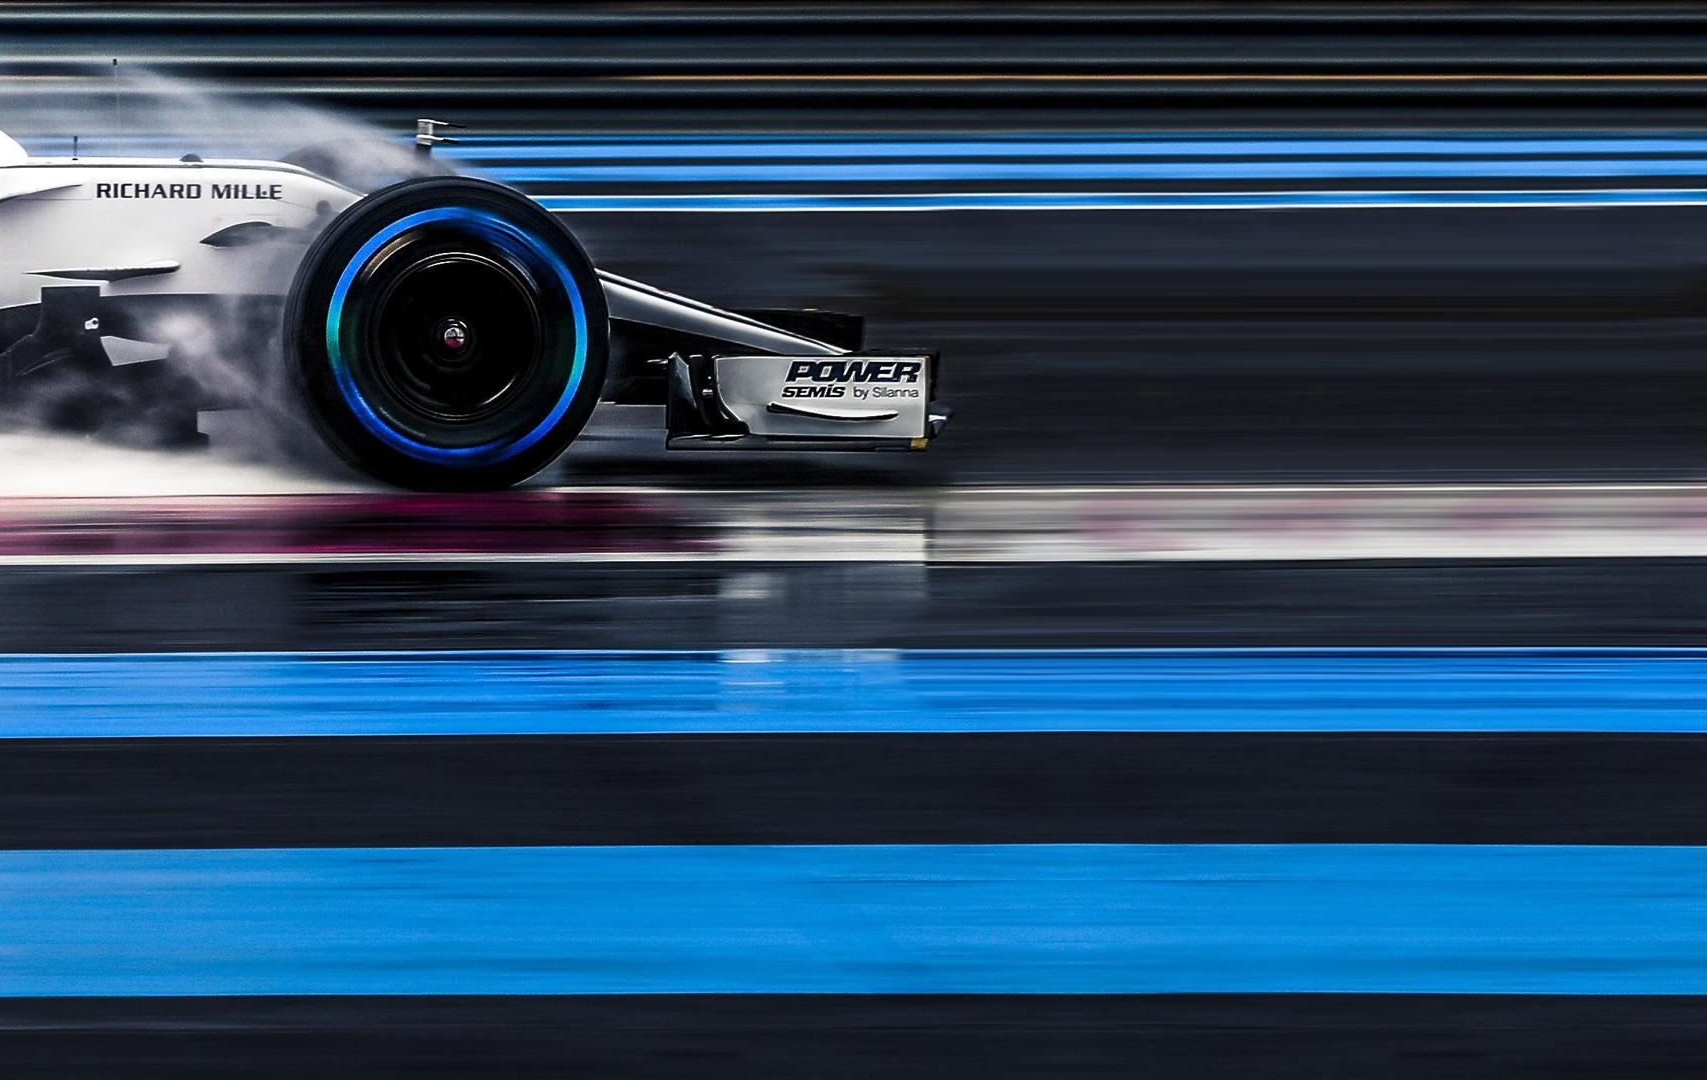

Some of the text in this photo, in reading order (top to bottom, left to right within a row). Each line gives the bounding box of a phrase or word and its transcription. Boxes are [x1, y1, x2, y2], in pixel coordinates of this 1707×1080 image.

[96, 183, 283, 200] RICHARD MILLE
[785, 361, 922, 383] POWER
[853, 386, 870, 400] by
[872, 386, 919, 398] Silanna
